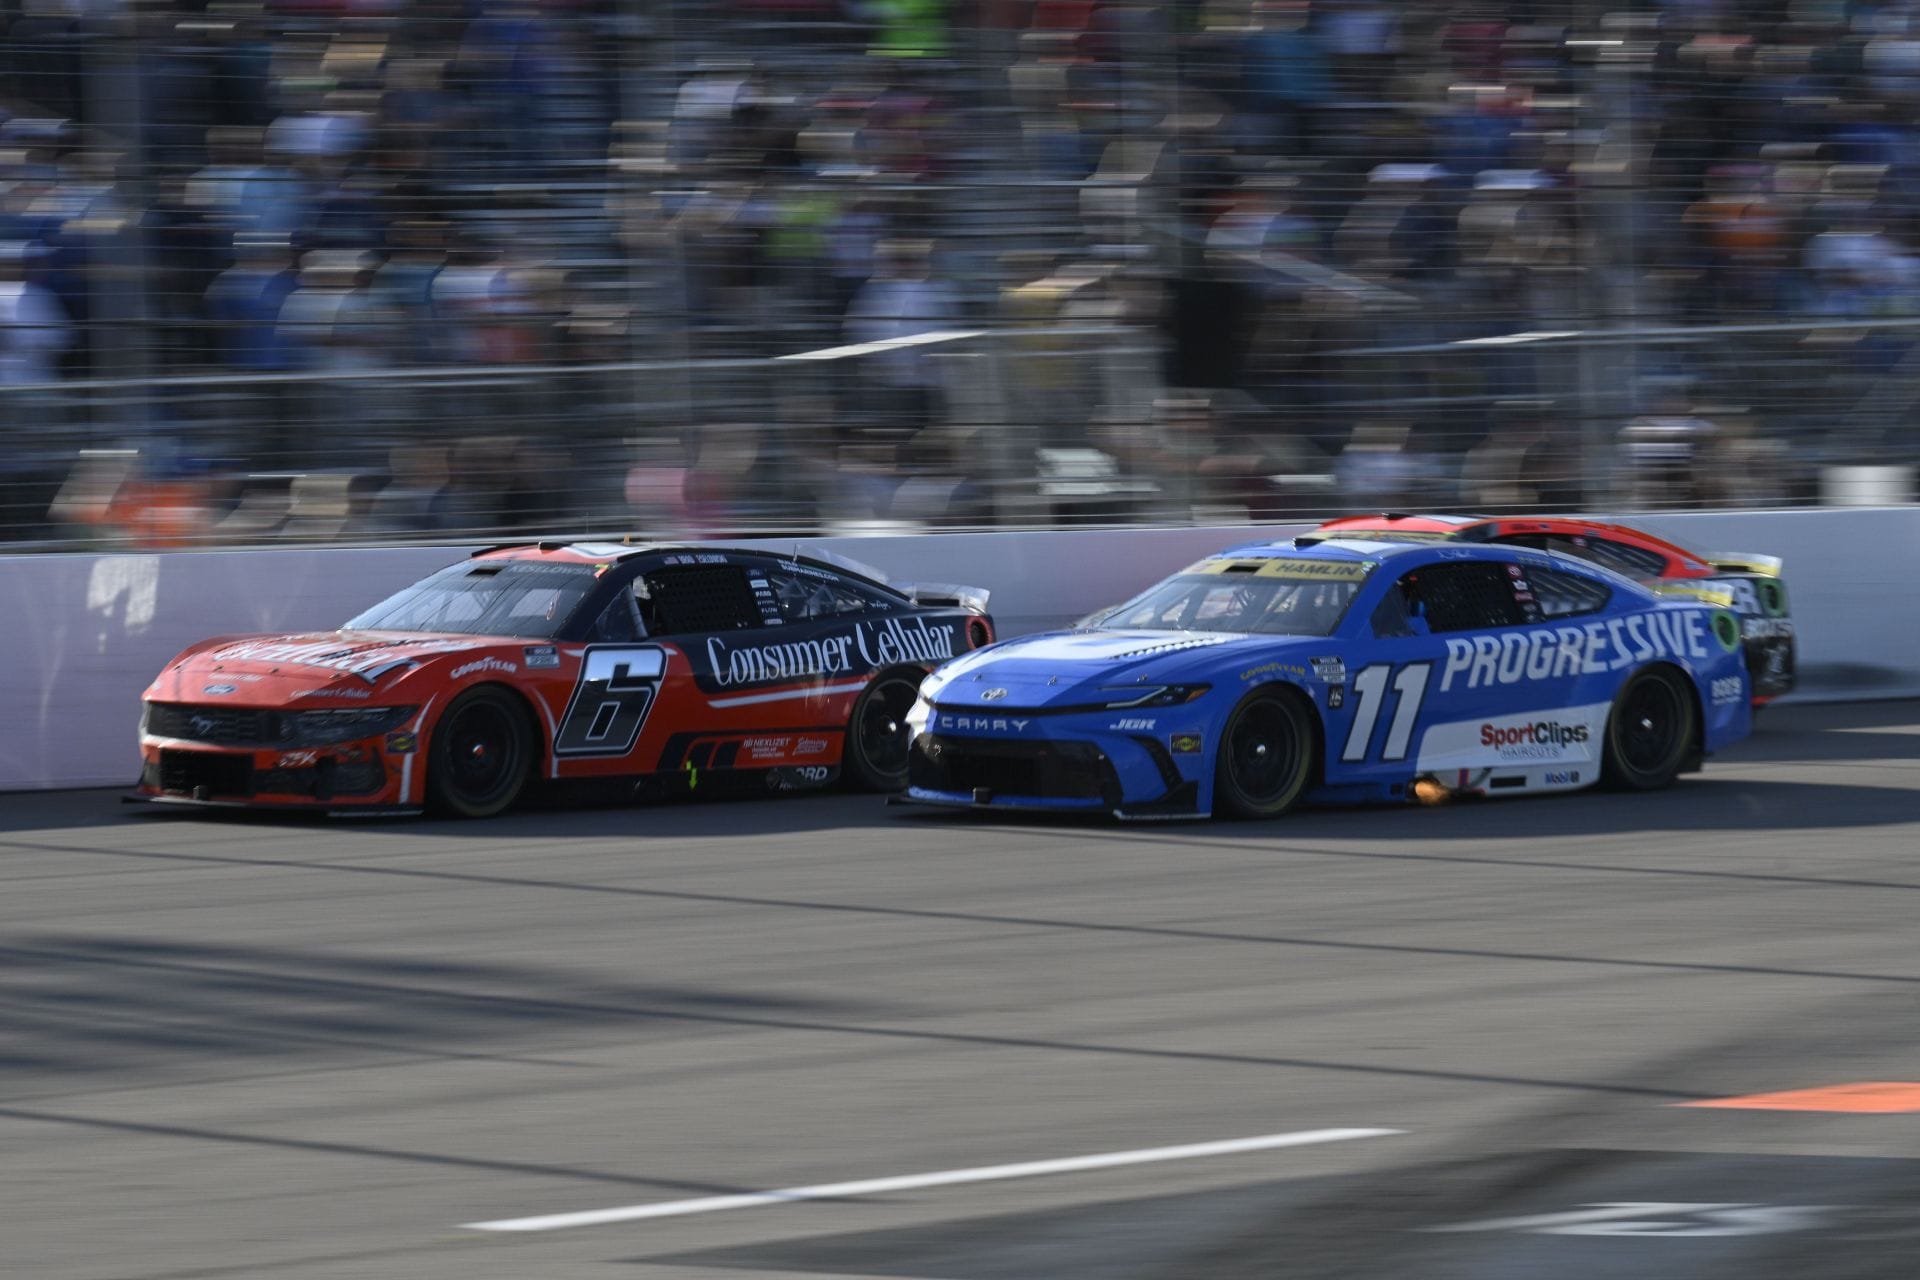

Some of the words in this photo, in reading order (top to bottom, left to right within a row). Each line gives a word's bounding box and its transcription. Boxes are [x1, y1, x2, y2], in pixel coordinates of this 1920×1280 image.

[1276, 563, 1358, 576] HAMLIN
[706, 636, 852, 687] Consumer
[856, 614, 954, 668] Cellular
[1440, 610, 1707, 692] PROGRESSIVE
[450, 655, 518, 680] GOODYEAR
[1240, 662, 1306, 681] GOODYEAR
[553, 643, 668, 760] 6
[1338, 661, 1433, 763] 11
[941, 716, 1029, 731] CAMRY
[1109, 718, 1157, 731] JGR
[1481, 721, 1589, 750] SportClips
[1502, 746, 1561, 759] HAIRCUTS
